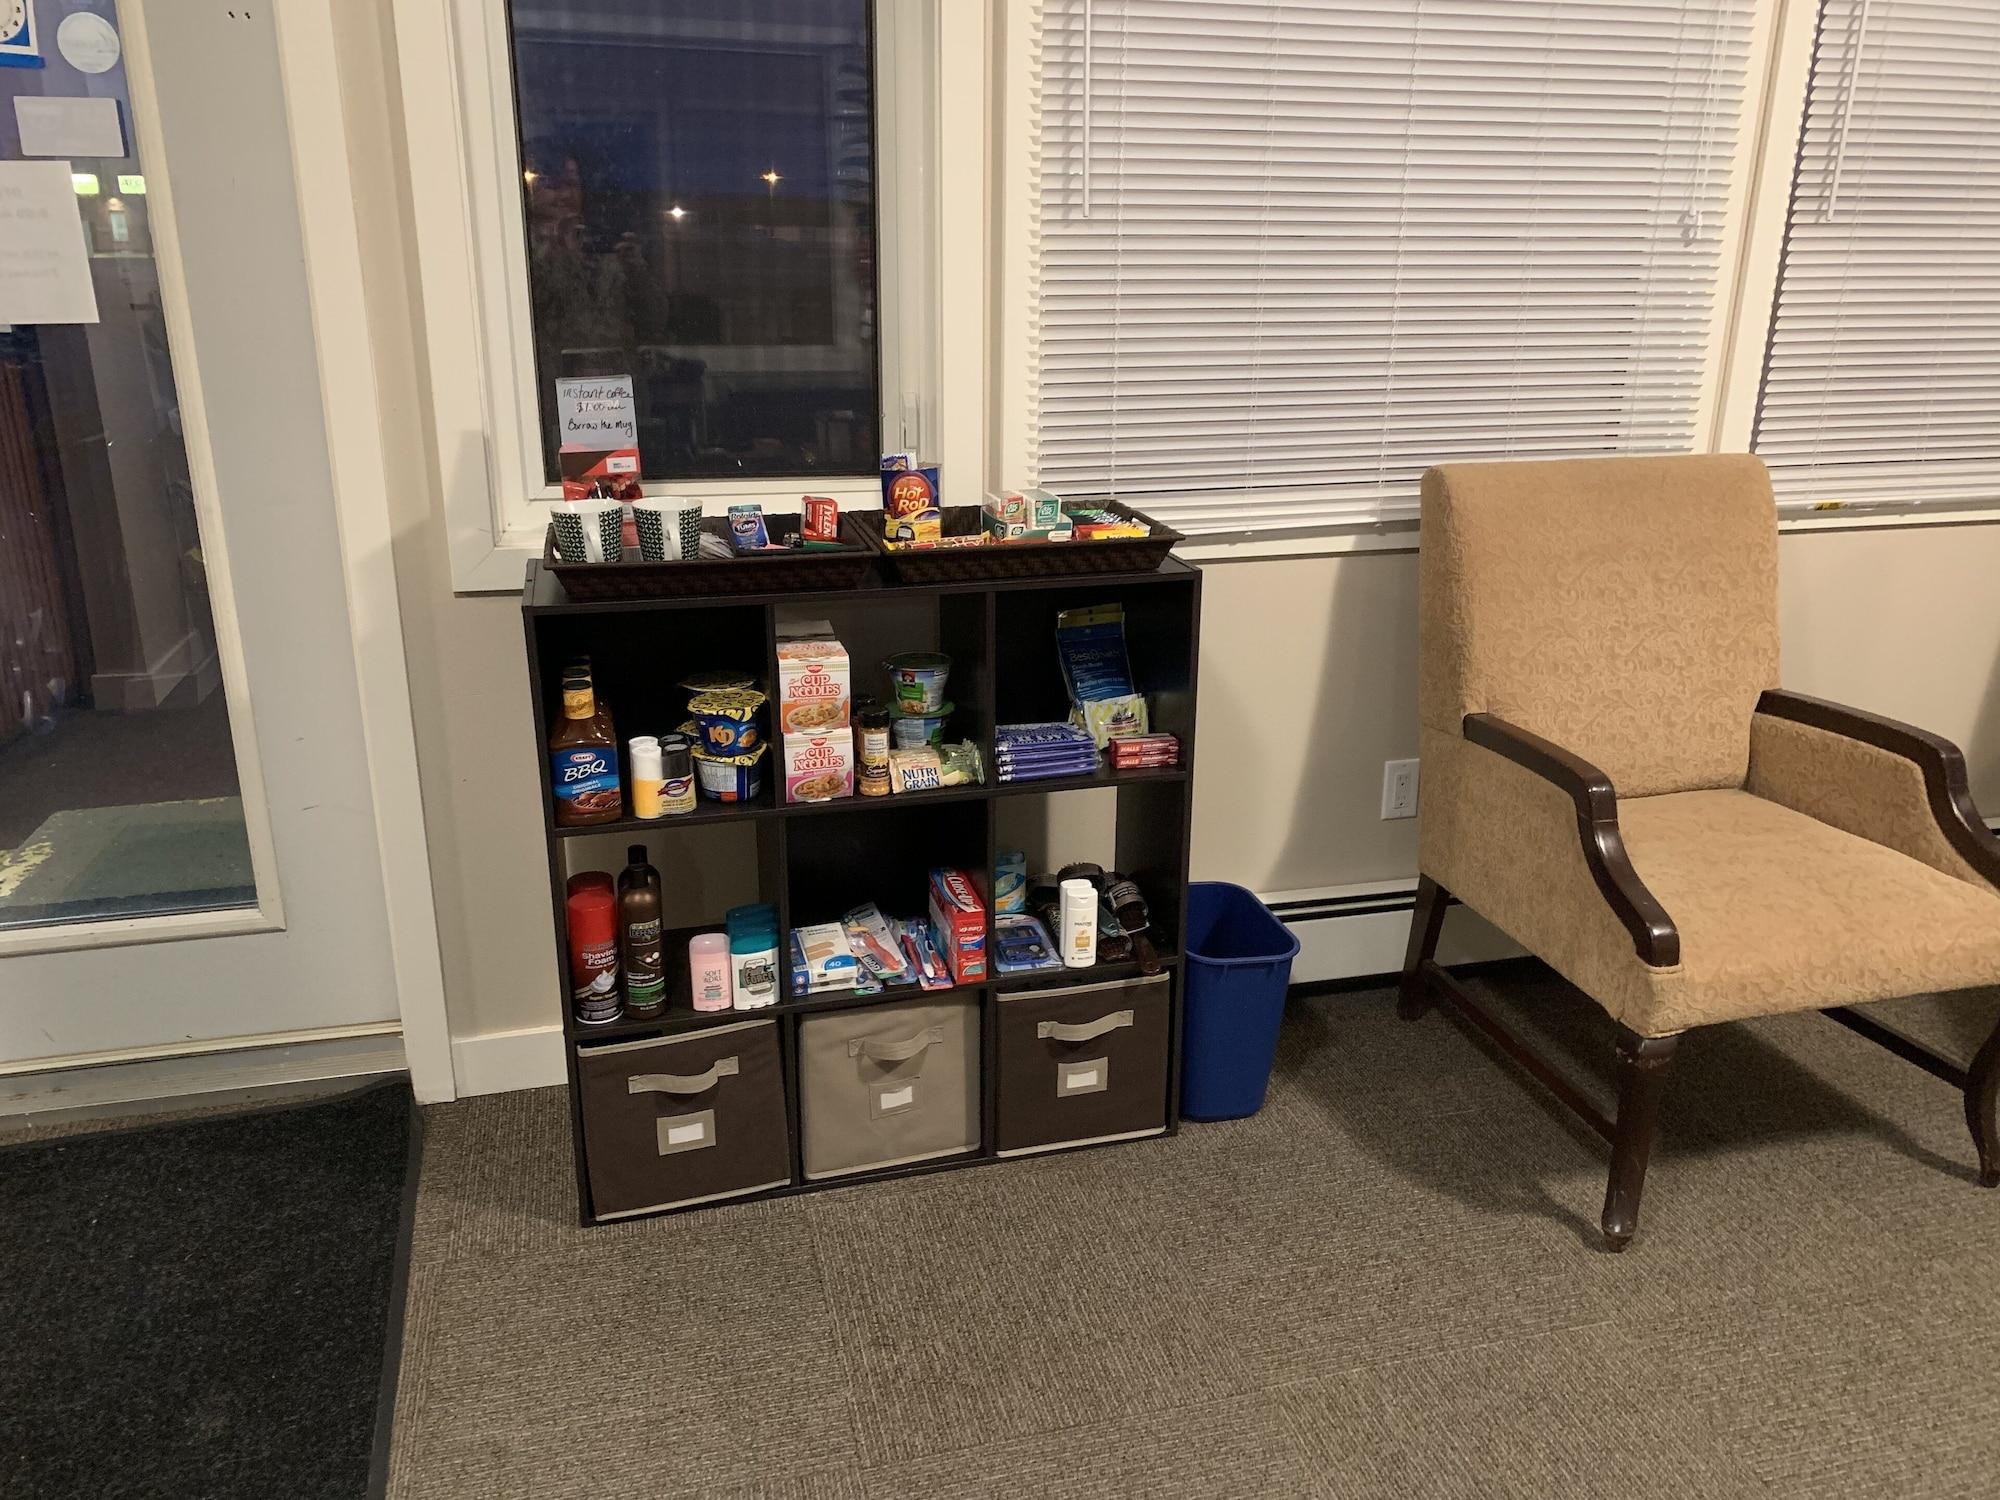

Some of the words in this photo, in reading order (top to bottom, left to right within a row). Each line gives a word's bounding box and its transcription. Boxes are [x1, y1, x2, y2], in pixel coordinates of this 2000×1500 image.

[822, 504, 834, 538] TYLEN
[801, 674, 831, 687] CUP
[789, 683, 841, 698] NOODLES
[805, 747, 834, 760] CUP
[793, 755, 845, 771] NOODLES
[564, 759, 609, 782] BBQ
[902, 767, 938, 781] NUTRI
[904, 775, 940, 790] GRAIN
[582, 947, 618, 960] Shaving
[588, 955, 615, 966] Foam
[828, 960, 842, 968] 40
